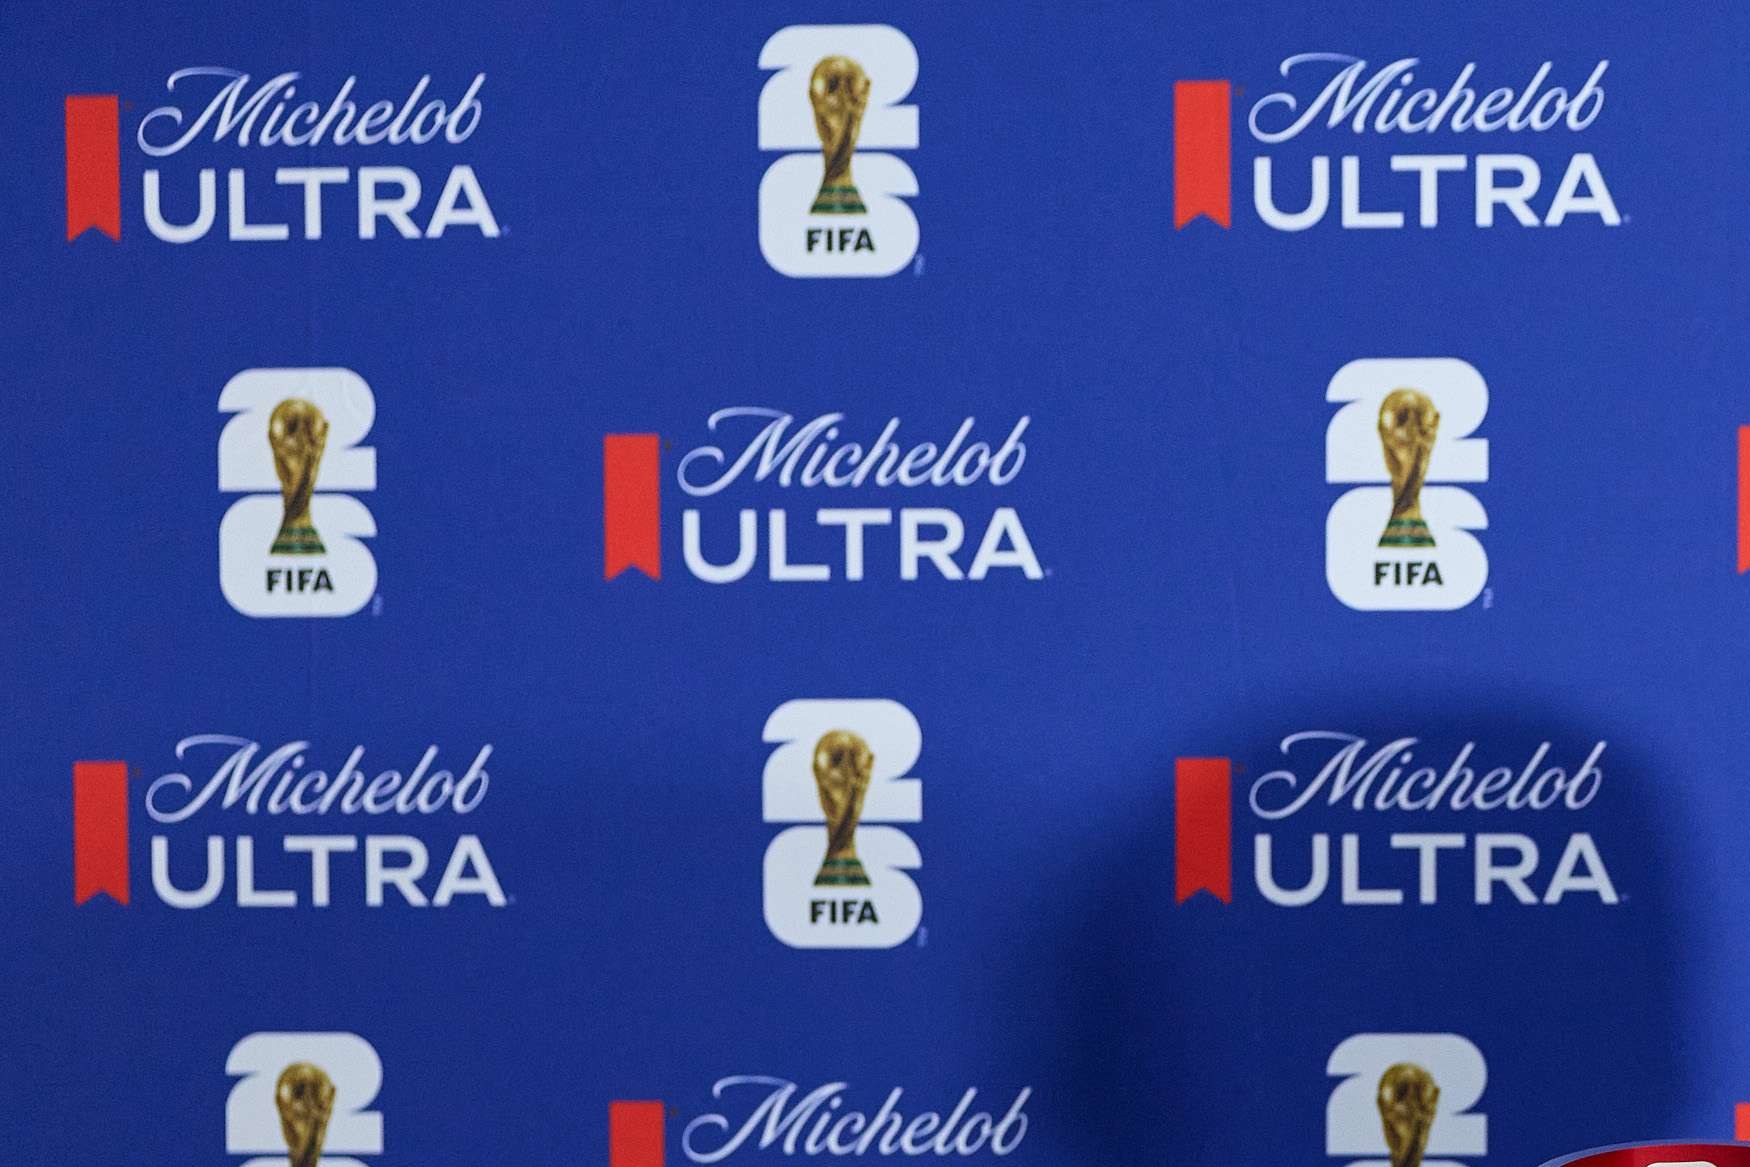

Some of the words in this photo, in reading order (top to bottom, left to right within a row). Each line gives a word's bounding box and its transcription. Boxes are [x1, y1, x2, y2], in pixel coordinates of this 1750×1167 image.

[137, 68, 487, 158] Michelob
[1249, 53, 1610, 145] Michelob
[143, 165, 502, 245] ULTRA
[1254, 153, 1623, 233] ULTRA
[806, 228, 876, 253] FIFA
[678, 407, 1032, 498] Michelob
[266, 568, 334, 593] FIFA
[683, 508, 1045, 585] ULTRA
[1374, 561, 1444, 586] FIFA
[146, 735, 495, 825] Michelob
[1249, 731, 1608, 821] Michelob
[151, 835, 509, 910] ULTRA
[1254, 833, 1620, 908] ULTRA
[810, 899, 879, 925] FIFA
[683, 1076, 1032, 1165] Michelob
